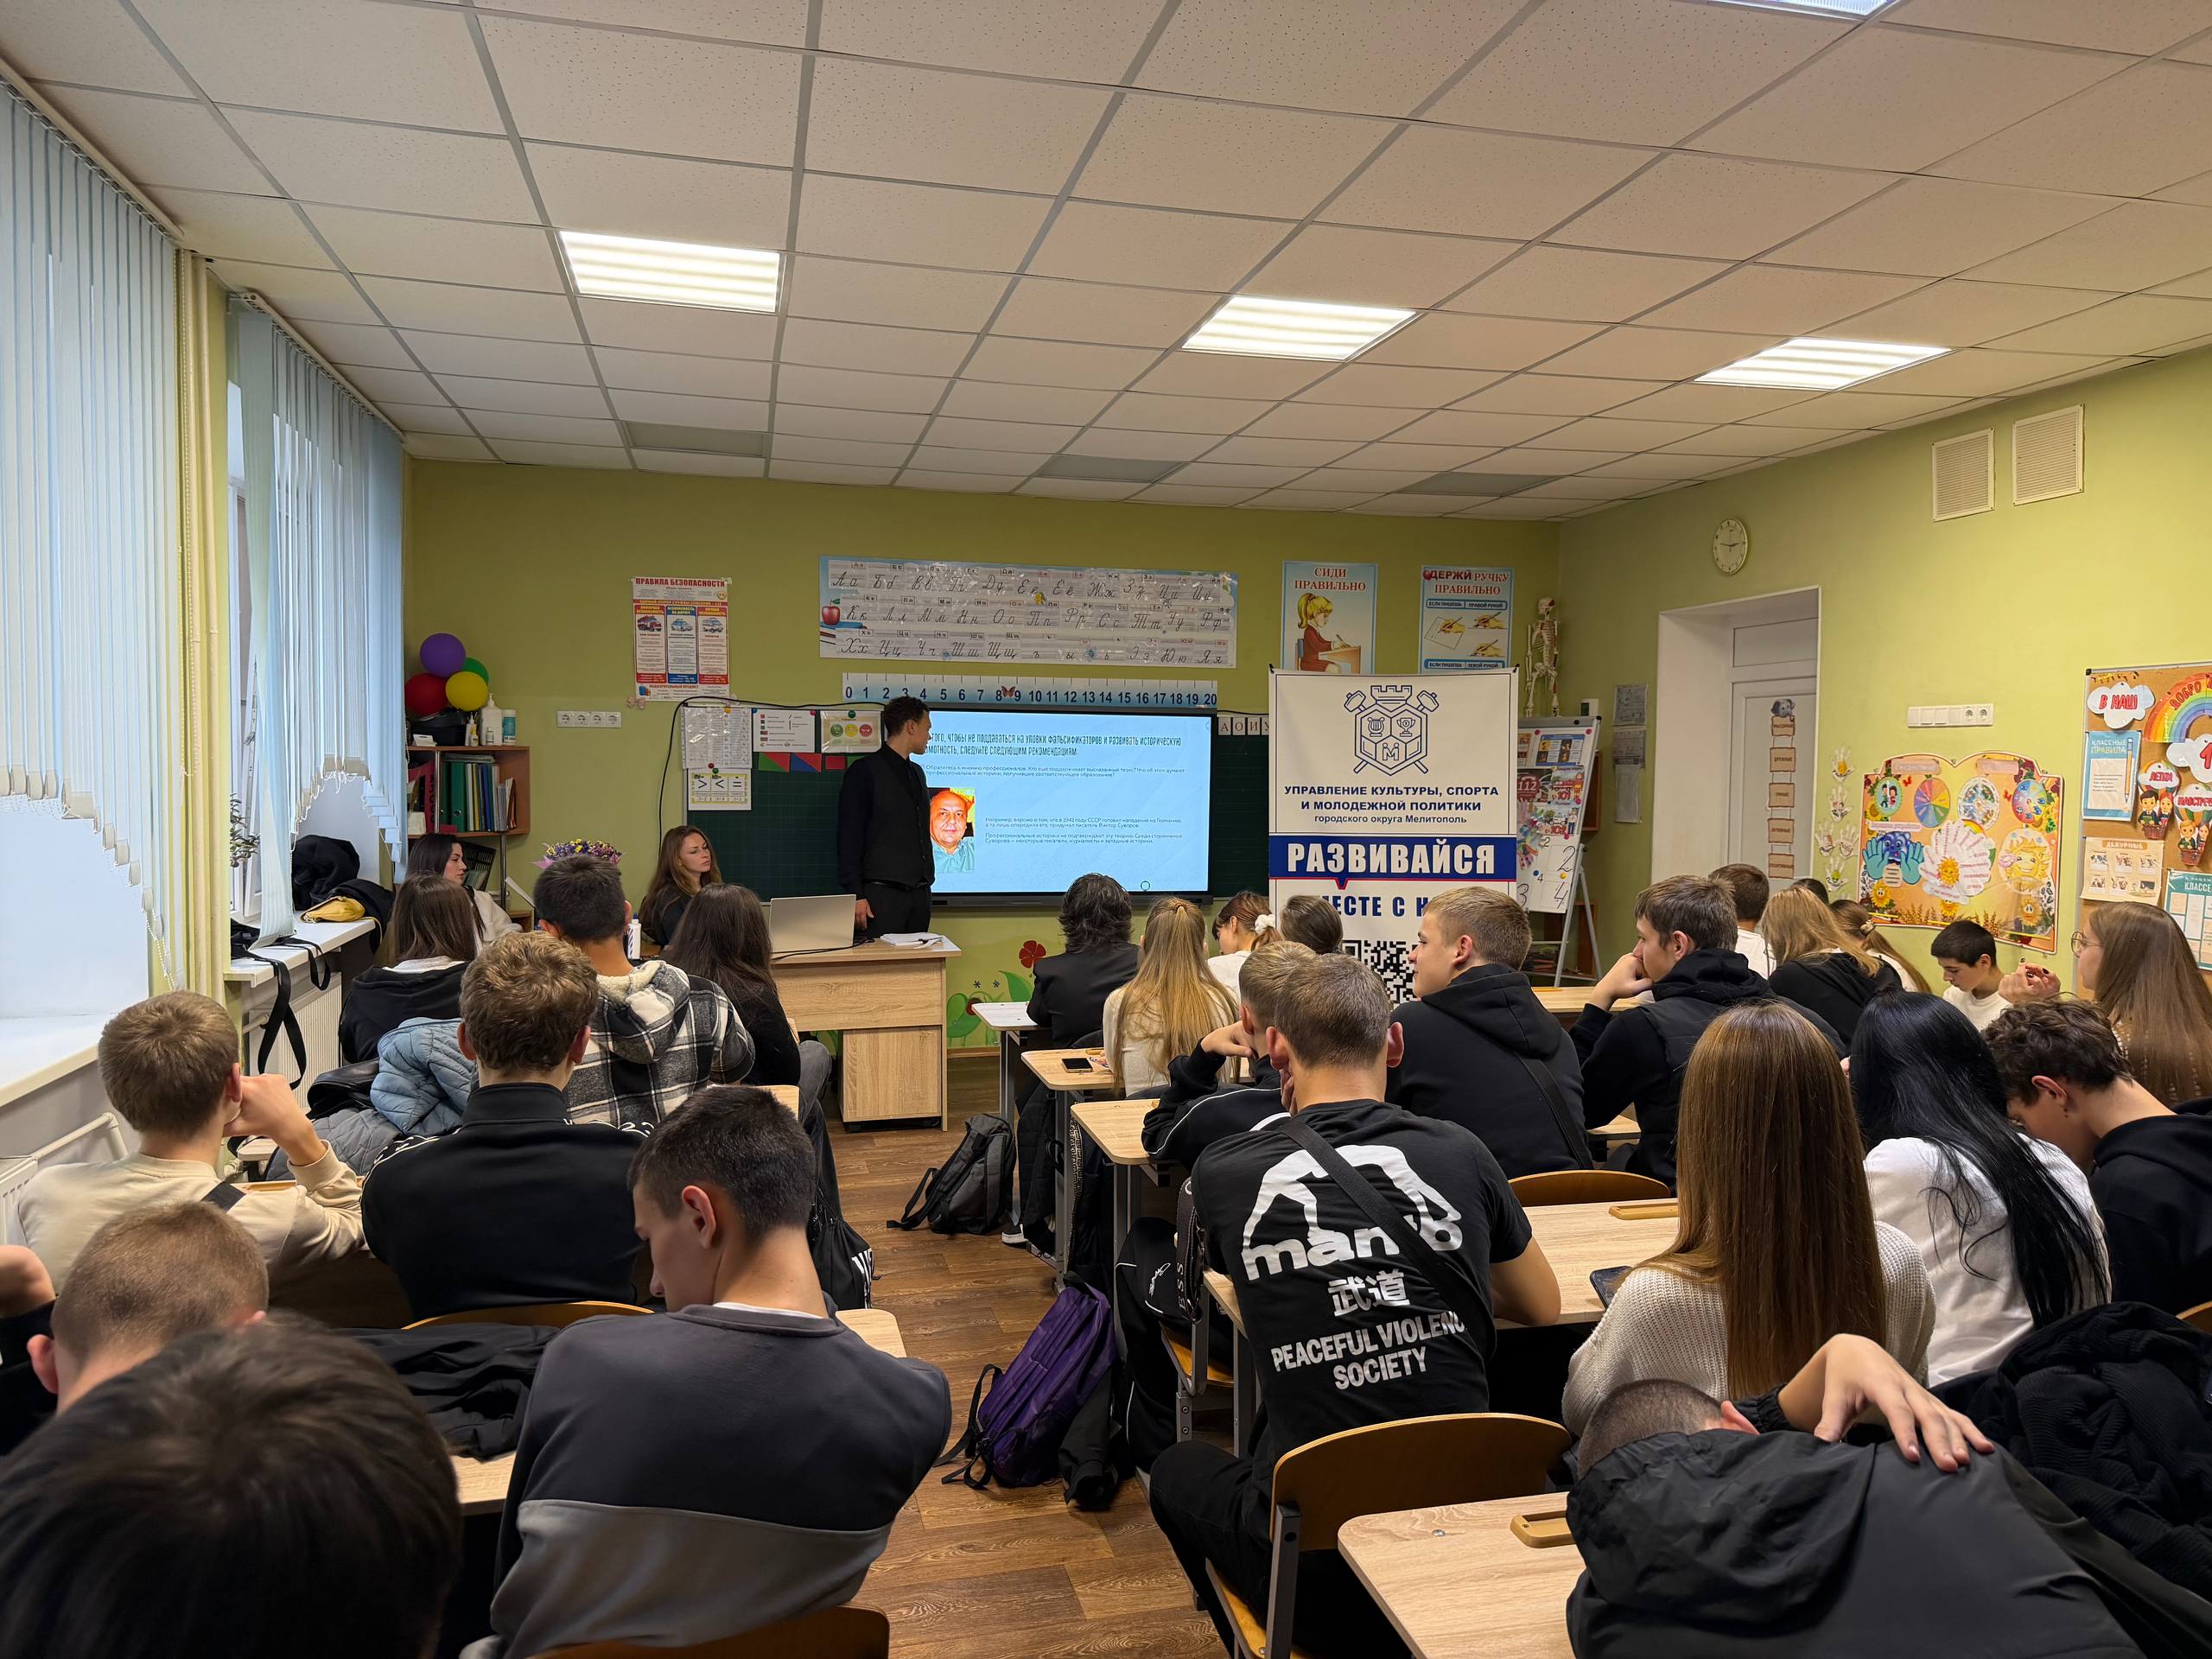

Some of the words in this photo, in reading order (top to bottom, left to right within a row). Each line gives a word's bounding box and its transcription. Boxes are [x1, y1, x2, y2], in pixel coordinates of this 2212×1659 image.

[1314, 568, 1346, 578] СИДИ
[1474, 573, 1508, 582] РУЧКУ
[1294, 581, 1366, 591] ПРАВИЛЬНО
[1435, 584, 1500, 594] ПРАВИЛЬНО
[845, 687, 852, 698] 0
[862, 687, 868, 698] 1
[883, 688, 890, 698] 2
[919, 688, 927, 699] 4
[940, 689, 947, 700] 5
[959, 690, 965, 700] 6
[978, 690, 984, 700] 7
[995, 690, 1002, 701] 8
[1014, 690, 1021, 702] 9
[1028, 691, 1042, 702] 10
[1046, 692, 1058, 702] 11
[1064, 691, 1077, 702] 12
[1082, 692, 1096, 703] 13
[1099, 692, 1113, 703] 14
[1118, 692, 1131, 703] 15
[1135, 693, 1149, 704] 16
[1154, 693, 1166, 704] 17
[1170, 693, 1182, 705] 18
[1185, 693, 1198, 705] 19
[1204, 695, 1217, 705] 20
[2170, 681, 2202, 710] ДОБРО
[2099, 695, 2107, 709] В
[2111, 695, 2138, 709] НАШ
[1220, 722, 1229, 732] А
[1235, 722, 1243, 731] О
[1249, 721, 1258, 732] И
[1285, 786, 1367, 795] УПРАВЛЕНИЕ
[1371, 787, 1442, 797] КУЛЬТУРЫ,
[1446, 787, 1498, 796] СПОРТА
[1518, 781, 1537, 791] 112
[1314, 800, 1406, 811] МОЛОДЕЖНОЙ
[1410, 802, 1481, 810] ПОЛИТИКИ
[1543, 837, 1550, 847] 2
[1287, 839, 1495, 874] РАЗВИВАЙСЯ
[1557, 846, 1575, 872] 2
[1537, 874, 1543, 882] 4
[2184, 881, 2210, 892] КЛАССЕ
[1554, 882, 1568, 909] 4
[1322, 895, 1381, 916] ЕСТЕ
[1393, 897, 1405, 917] С
[1328, 1268, 1410, 1317] 武道
[1270, 1328, 1379, 1372] PEACEFUL
[1333, 1346, 1427, 1390] SOCIETY
